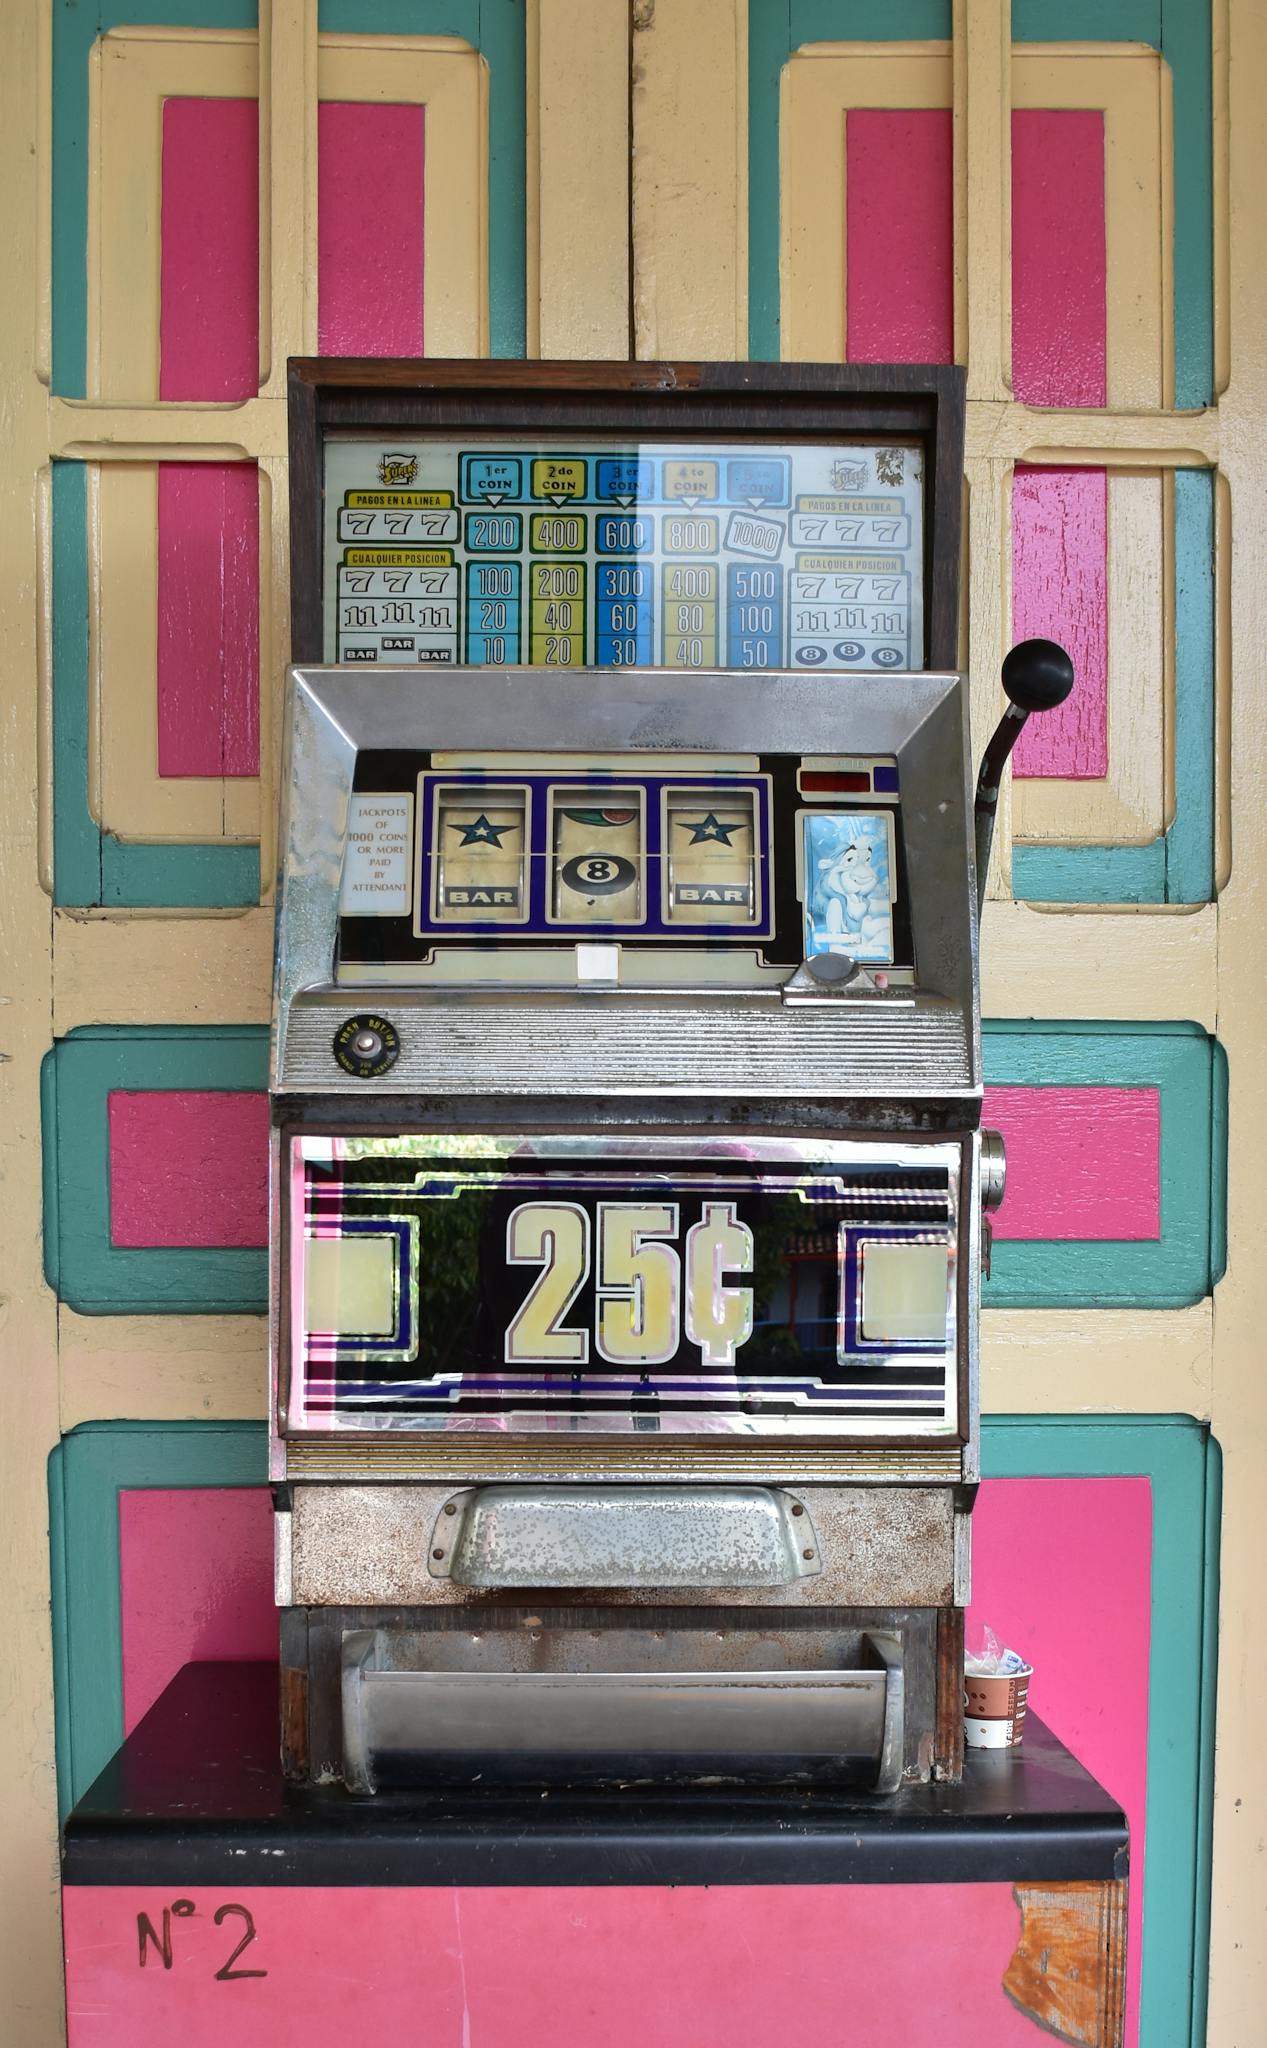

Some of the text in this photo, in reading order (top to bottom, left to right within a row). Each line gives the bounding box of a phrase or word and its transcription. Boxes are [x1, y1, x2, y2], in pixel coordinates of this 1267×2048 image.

[478, 480, 512, 490] COIN
[542, 481, 576, 490] COIN
[608, 481, 641, 490] COIN
[674, 482, 707, 491] COIN
[357, 496, 441, 506] PAGOS EN LA LINEA
[808, 501, 892, 512] PAGOS EN LA LINEA
[347, 514, 450, 536] 7 7 7
[474, 519, 514, 547] 200
[538, 520, 578, 548] 400
[605, 521, 644, 549] 600
[671, 521, 709, 549] 800
[734, 521, 778, 551] 1000
[800, 520, 901, 542] 7 7 7
[352, 554, 446, 564] CUALQUIER POSICION
[804, 559, 897, 570] CUALQUIER POSICION
[346, 571, 449, 594] 7 7 7
[478, 568, 512, 596] 100
[538, 568, 578, 596] 200
[605, 568, 644, 597] 300
[671, 568, 710, 597] 400
[736, 570, 774, 598] 500
[797, 577, 901, 600] 7 7 7
[344, 602, 452, 628] 11 11 11
[480, 602, 506, 630] 20
[544, 602, 571, 631] 40
[611, 604, 637, 632] 60
[678, 605, 703, 633] 80
[739, 606, 772, 633] 100
[797, 608, 904, 634] 11 11 11
[346, 639, 450, 660] BAR BAR BAR
[483, 636, 505, 664] 10
[546, 636, 572, 664] 20
[611, 638, 637, 666] 30
[676, 639, 702, 666] 40
[743, 640, 768, 668] 50
[806, 646, 892, 660] 8 8 8
[359, 809, 406, 817] JACKPOTS
[376, 821, 388, 829] OF
[348, 833, 408, 842] 1000 COINS
[357, 846, 404, 854] OR MORE
[374, 871, 385, 879] BY
[586, 861, 610, 880] 8
[450, 892, 513, 903] BAR
[679, 889, 743, 901] BAR
[504, 1201, 754, 1366] 25¢
[214, 1903, 268, 1981] 2
